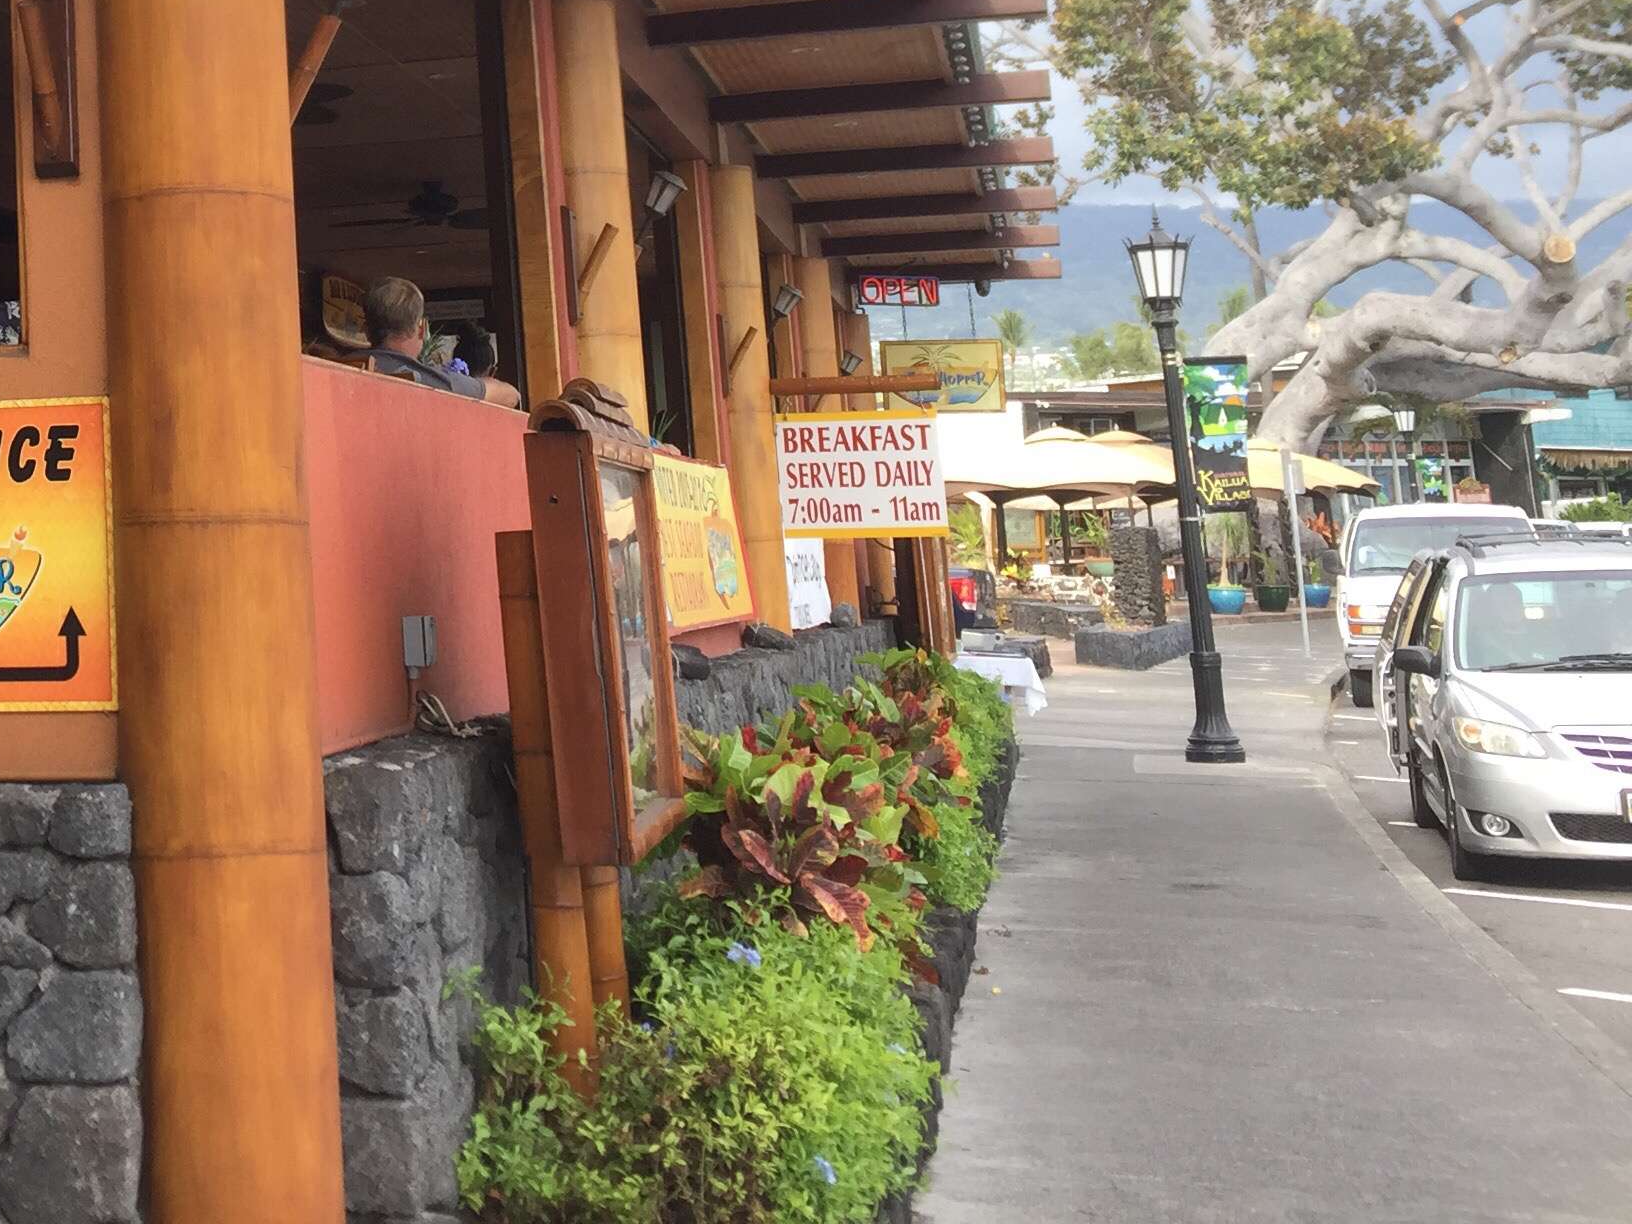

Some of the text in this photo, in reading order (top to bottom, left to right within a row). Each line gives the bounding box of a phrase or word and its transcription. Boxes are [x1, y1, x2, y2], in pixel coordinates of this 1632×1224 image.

[861, 276, 937, 305] OPEN
[783, 424, 931, 454] BREAKFAST
[786, 460, 934, 490] SERVED DAILY
[1198, 470, 1248, 491] KAILUA
[788, 497, 863, 525] 7:00am
[889, 496, 941, 522] 11am
